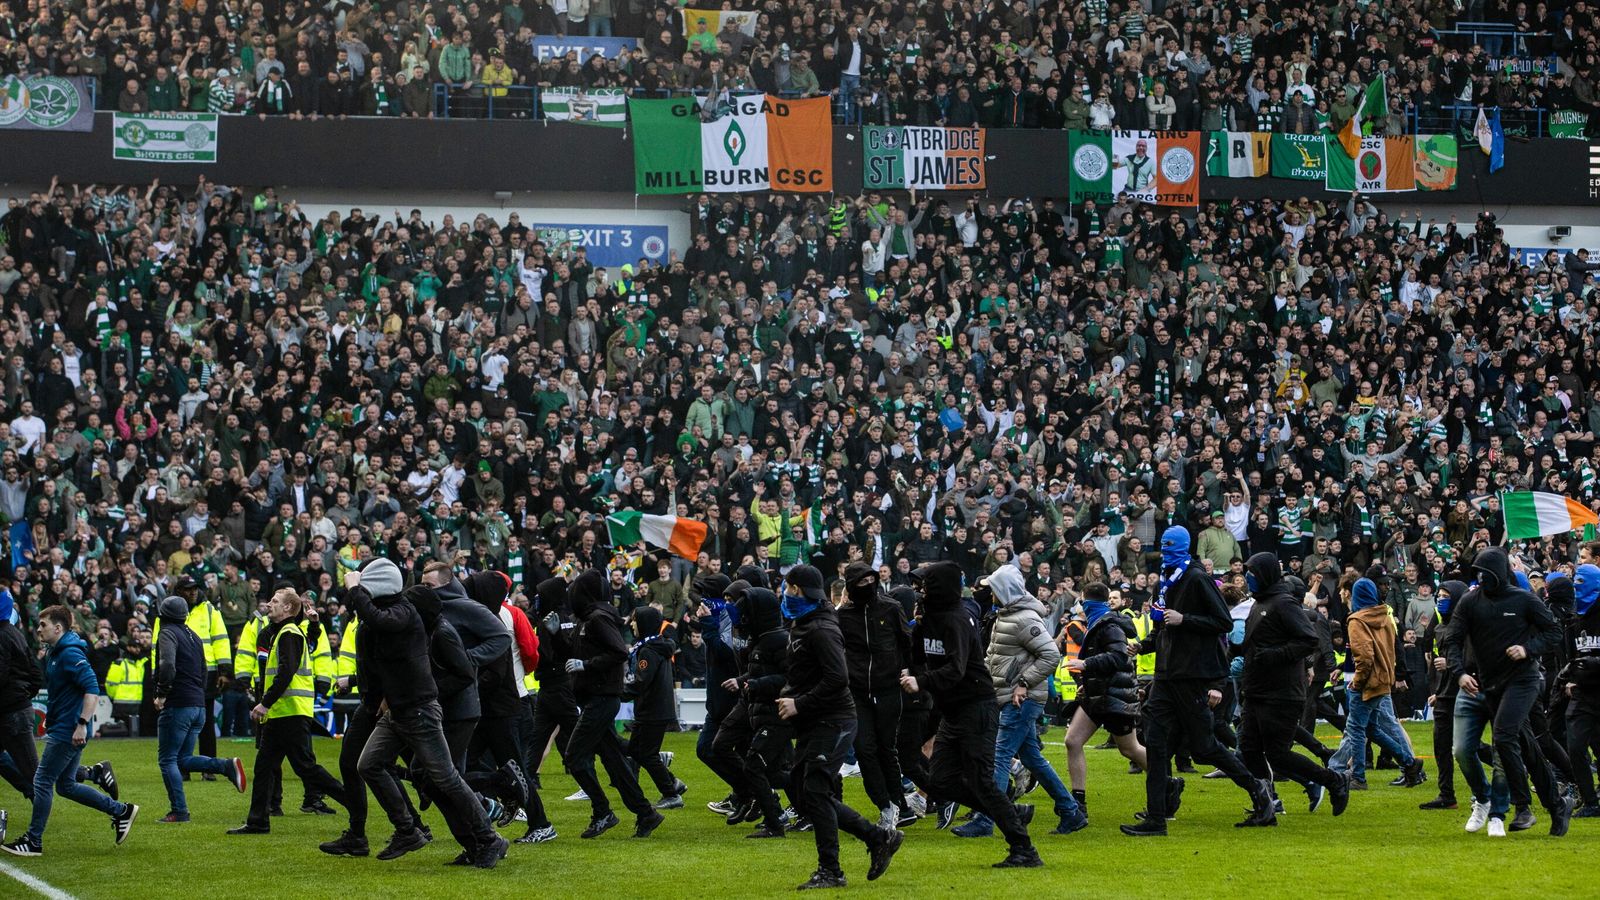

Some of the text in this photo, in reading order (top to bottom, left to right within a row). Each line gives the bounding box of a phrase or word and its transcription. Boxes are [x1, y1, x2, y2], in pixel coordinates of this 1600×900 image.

[671, 101, 790, 117] GANGAD
[154, 131, 177, 139] 1946
[1080, 130, 1188, 139] KEVIN LAING
[1360, 141, 1381, 149] CSC
[645, 167, 823, 187] MILLBURN CSC
[869, 155, 981, 185] ST. JAMES
[1074, 191, 1193, 202] NEVER ORGOTTEN
[620, 230, 633, 247] 3
[1526, 253, 1567, 269] ET
